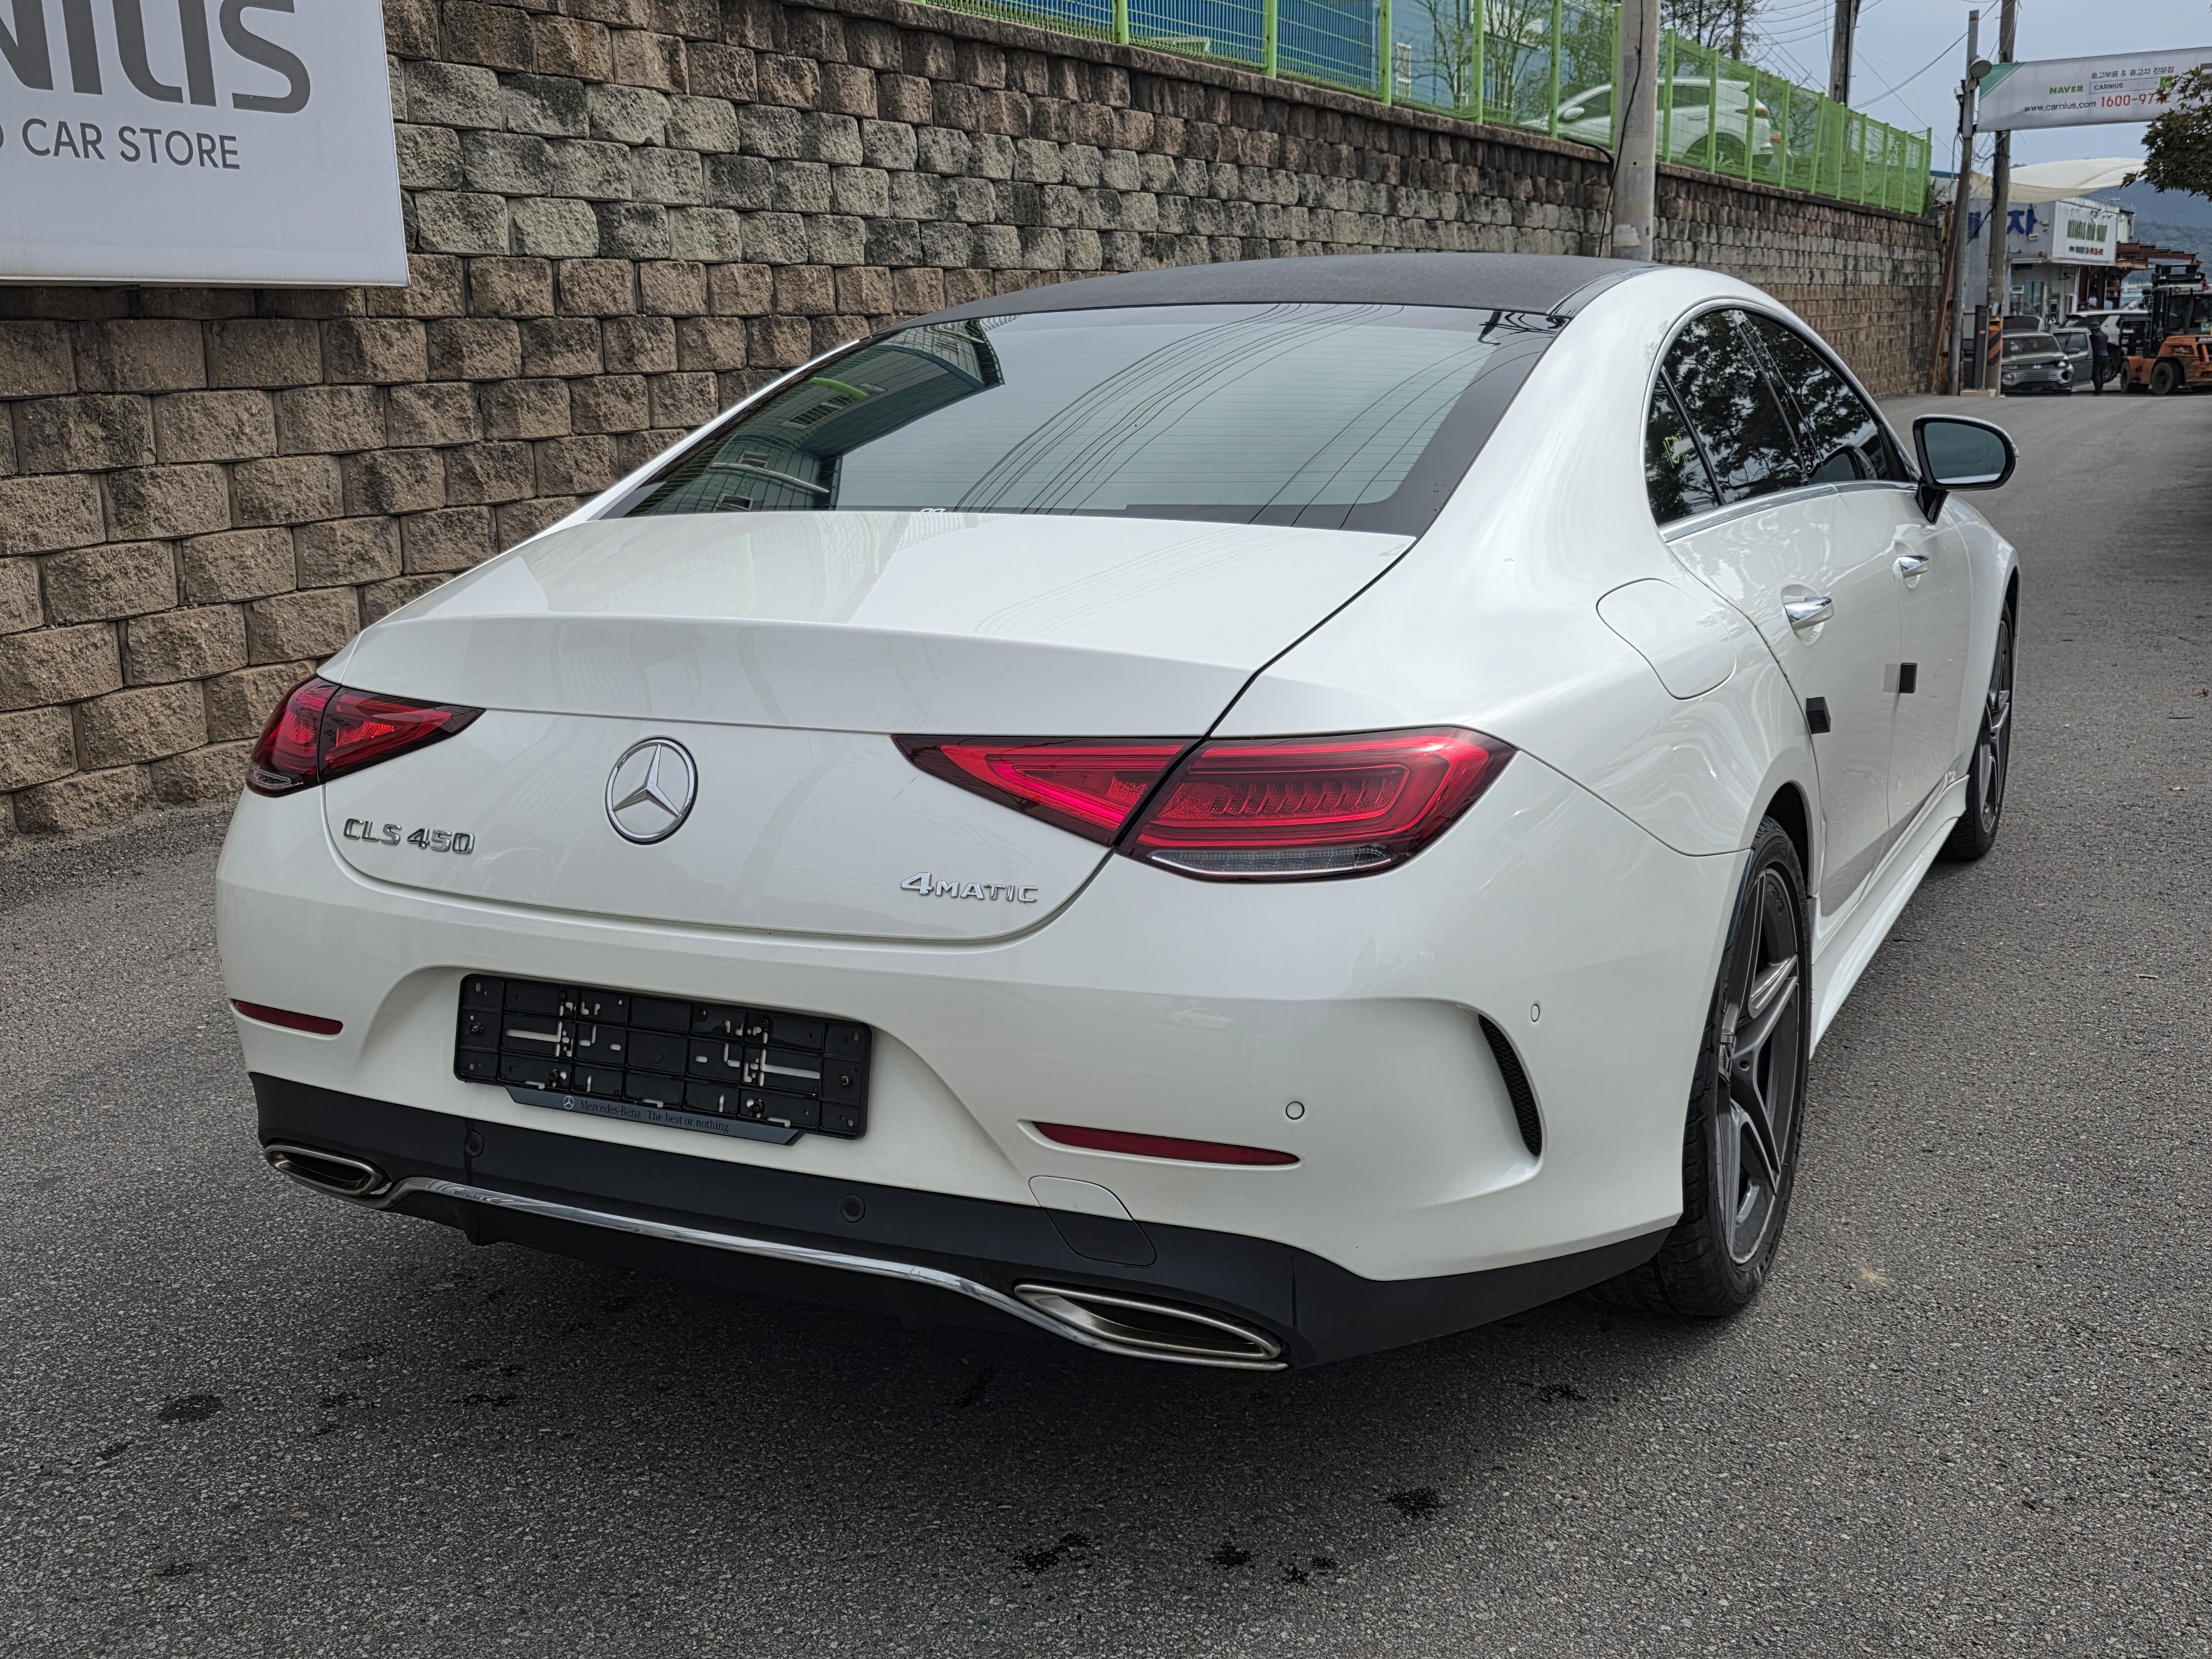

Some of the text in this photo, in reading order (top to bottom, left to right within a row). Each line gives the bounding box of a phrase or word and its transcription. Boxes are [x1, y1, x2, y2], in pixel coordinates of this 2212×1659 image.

[2025, 101, 2096, 111] www.carnius.com
[2049, 86, 2083, 94] NAVER
[22, 118, 106, 160] CAR
[118, 126, 240, 170] STORE
[343, 818, 475, 854] CLS 450
[580, 1099, 732, 1134] Mercedes-Benz The best or nothing.
